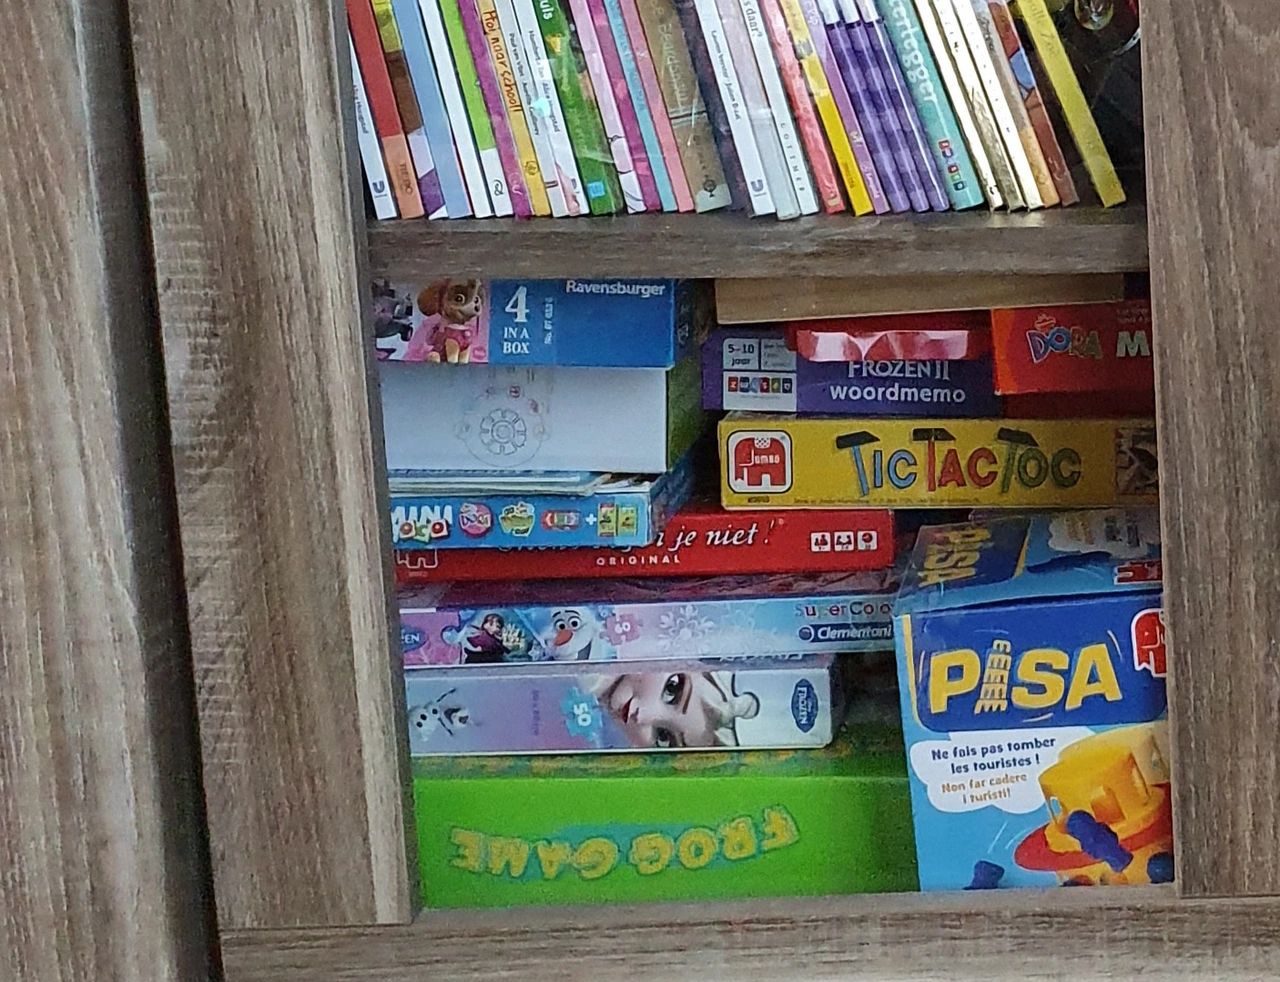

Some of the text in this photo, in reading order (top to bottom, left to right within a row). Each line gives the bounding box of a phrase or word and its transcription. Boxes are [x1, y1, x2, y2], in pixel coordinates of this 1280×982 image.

[483, 10, 497, 32] Hoi
[491, 36, 508, 68] naar
[565, 279, 666, 299] Ravensburger
[504, 285, 531, 324] 4
[503, 326, 530, 339] IN A
[502, 341, 531, 355] BOX
[1025, 326, 1104, 364] DORA
[847, 360, 935, 379] FROZEN
[829, 382, 966, 404] woordmemo
[668, 524, 695, 551] je
[596, 553, 681, 566] ORIGINAL
[613, 621, 632, 633] 60
[929, 639, 1123, 715] PISA
[573, 702, 592, 727] 50
[931, 737, 1057, 762] Ne fais pas tomber
[950, 760, 970, 776] les
[972, 756, 1033, 773] touristes
[941, 772, 1028, 795] Non far cadere
[969, 786, 1012, 804] turisti!
[448, 803, 801, 881] FROG GAME
